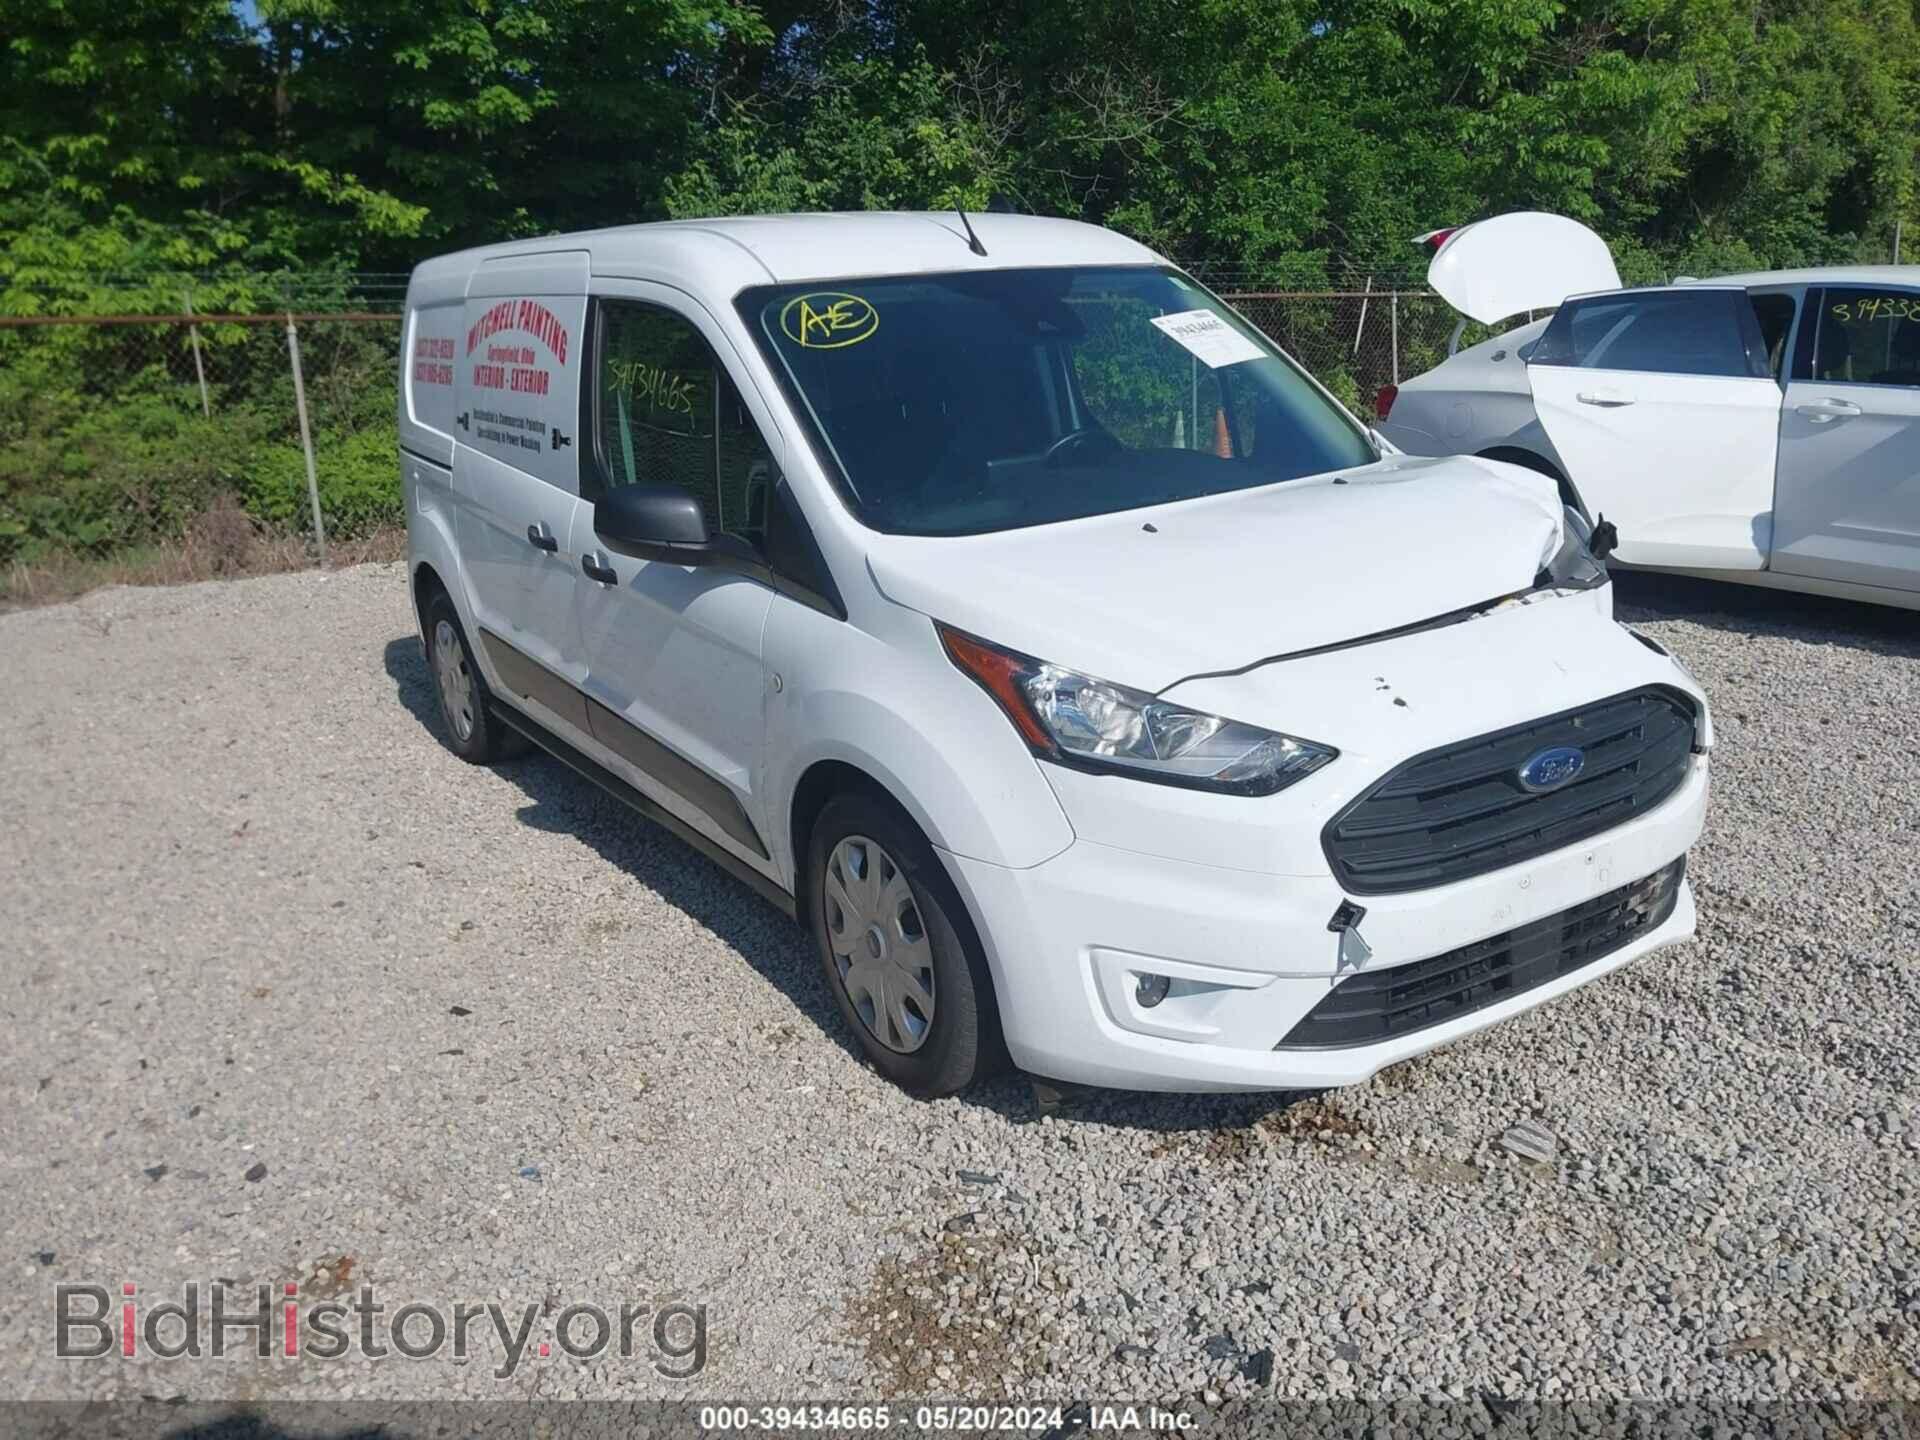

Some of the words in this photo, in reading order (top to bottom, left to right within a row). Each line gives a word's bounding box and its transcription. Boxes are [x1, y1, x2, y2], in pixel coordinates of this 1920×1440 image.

[467, 300, 517, 357] MITCHELL
[517, 300, 568, 366] PAINTING
[474, 365, 504, 389] INTERIOR
[511, 368, 549, 395] EXTERIOR
